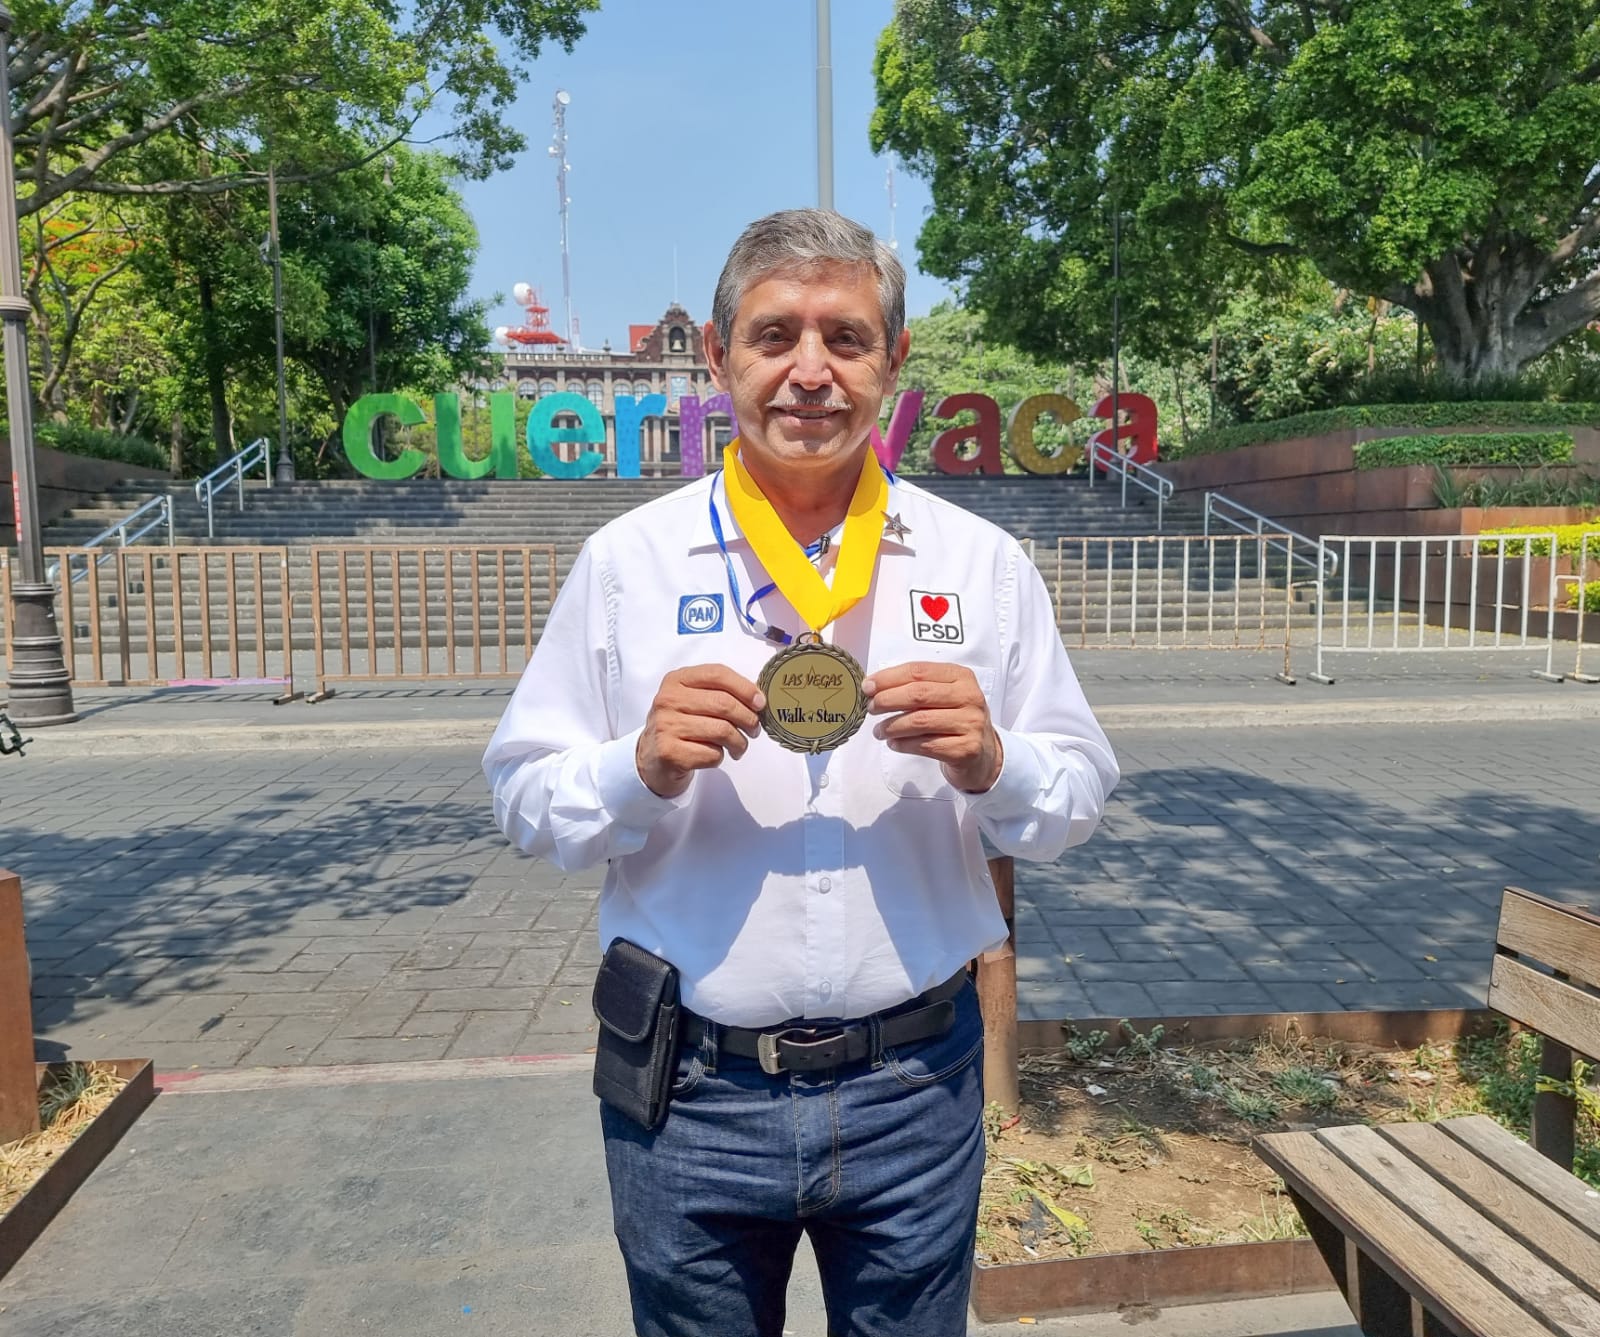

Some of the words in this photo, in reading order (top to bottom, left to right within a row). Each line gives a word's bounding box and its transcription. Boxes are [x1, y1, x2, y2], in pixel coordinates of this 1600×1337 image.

[342, 392, 1158, 479] cuernvaca
[688, 606, 714, 622] PAN
[917, 622, 960, 640] PSD
[783, 673, 803, 686] LAS
[806, 673, 843, 688] VEGAS
[776, 707, 805, 723] Walk
[816, 708, 846, 723] Stars
